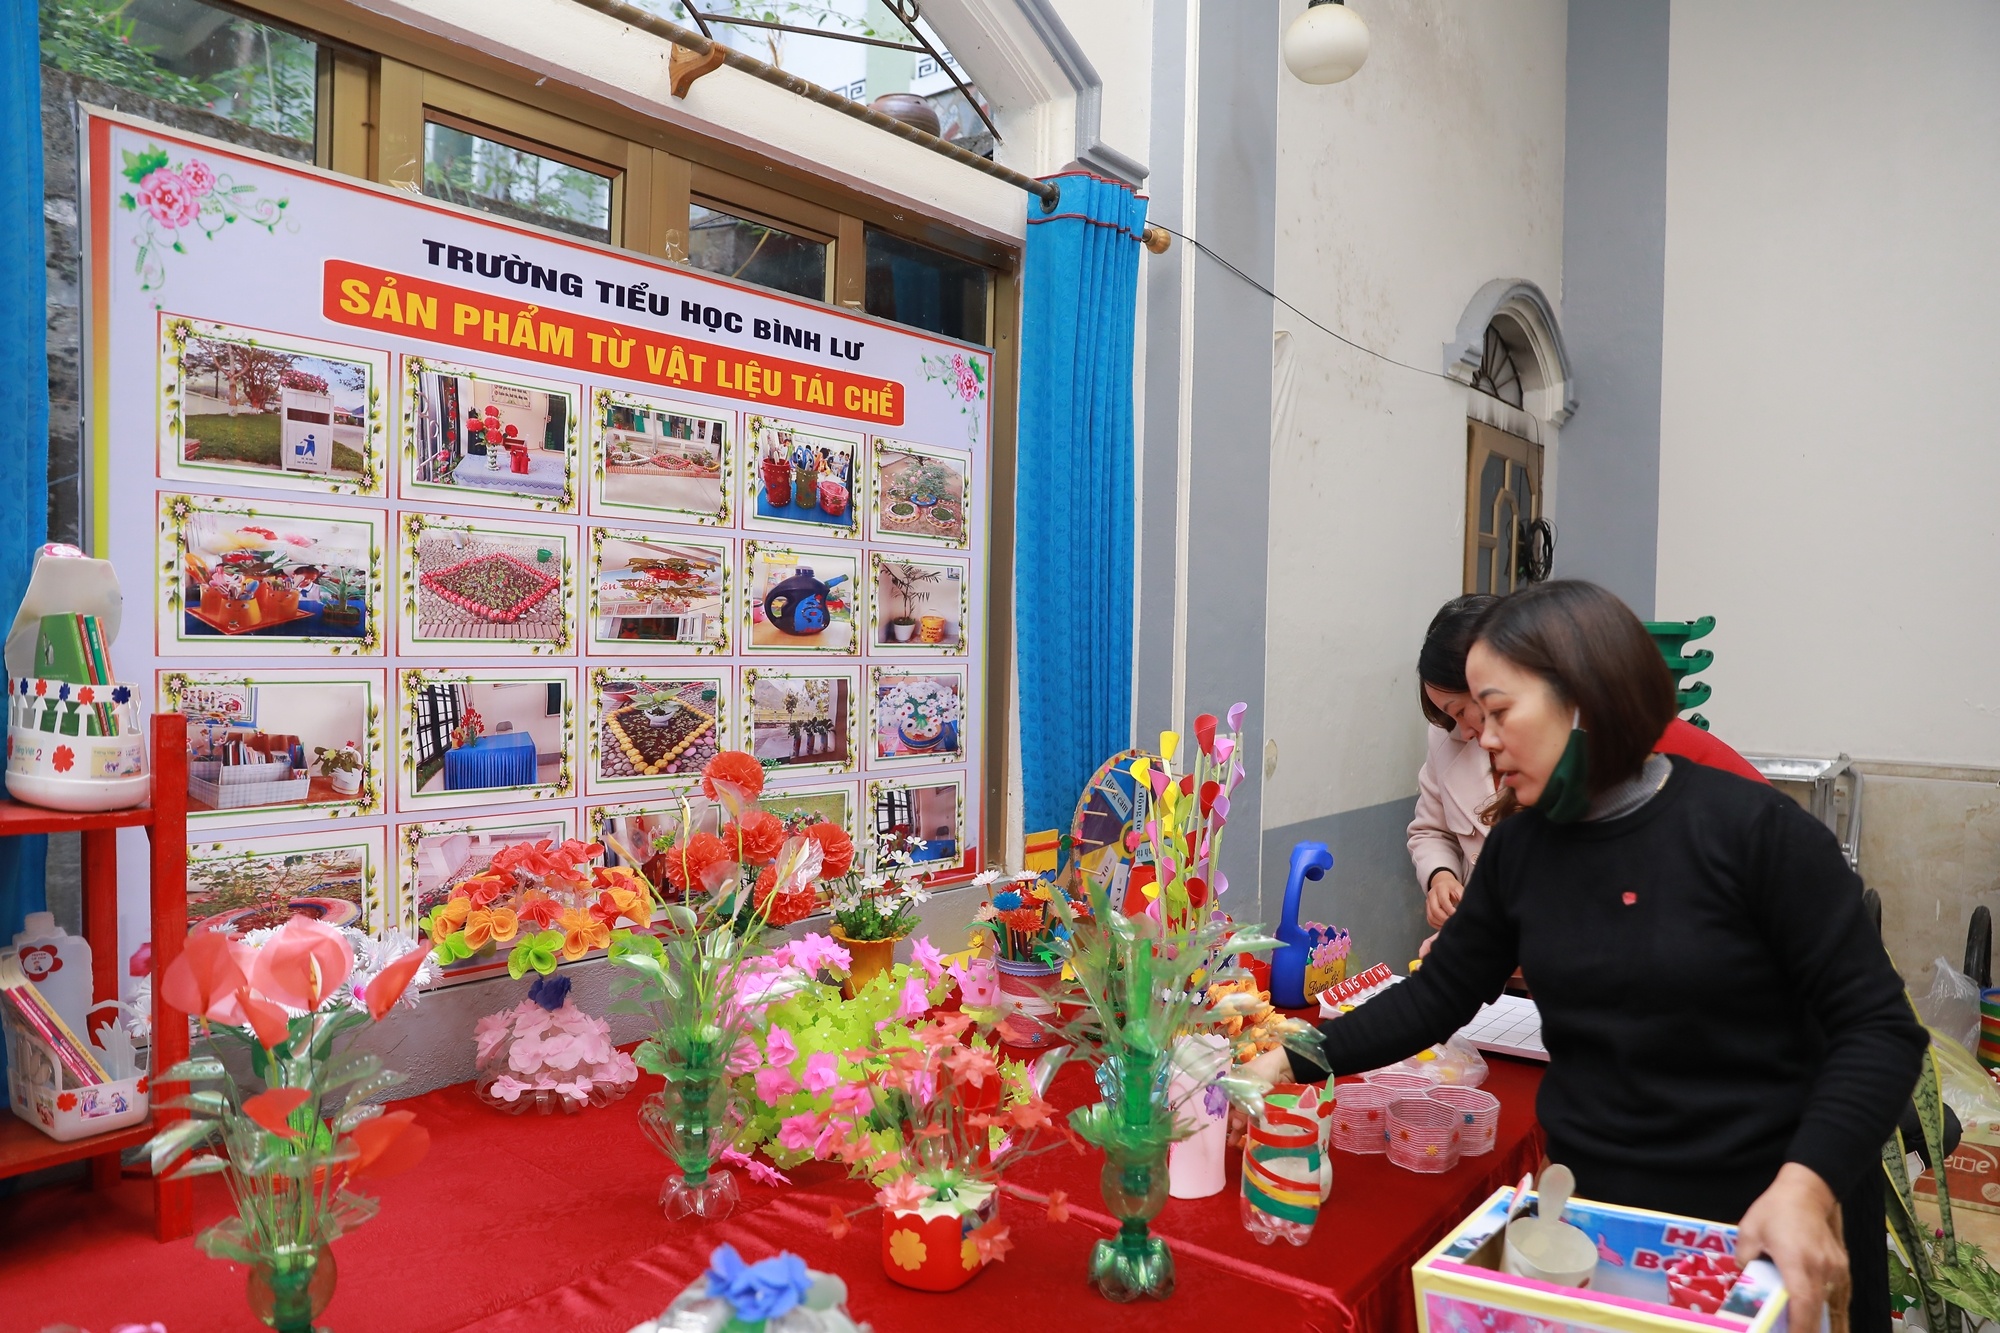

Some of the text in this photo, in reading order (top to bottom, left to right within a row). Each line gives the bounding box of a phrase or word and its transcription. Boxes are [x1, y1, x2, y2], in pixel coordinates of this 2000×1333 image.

[422, 238, 865, 361] TRƯỜNG TIỂU HỌC BÌNH LƯ
[339, 276, 894, 417] SẢN PHẨM TỪ VẬT LIỆU TÁI CHẾ
[35, 748, 42, 761] 2
[1136, 792, 1145, 818] động
[1136, 819, 1142, 832] từ
